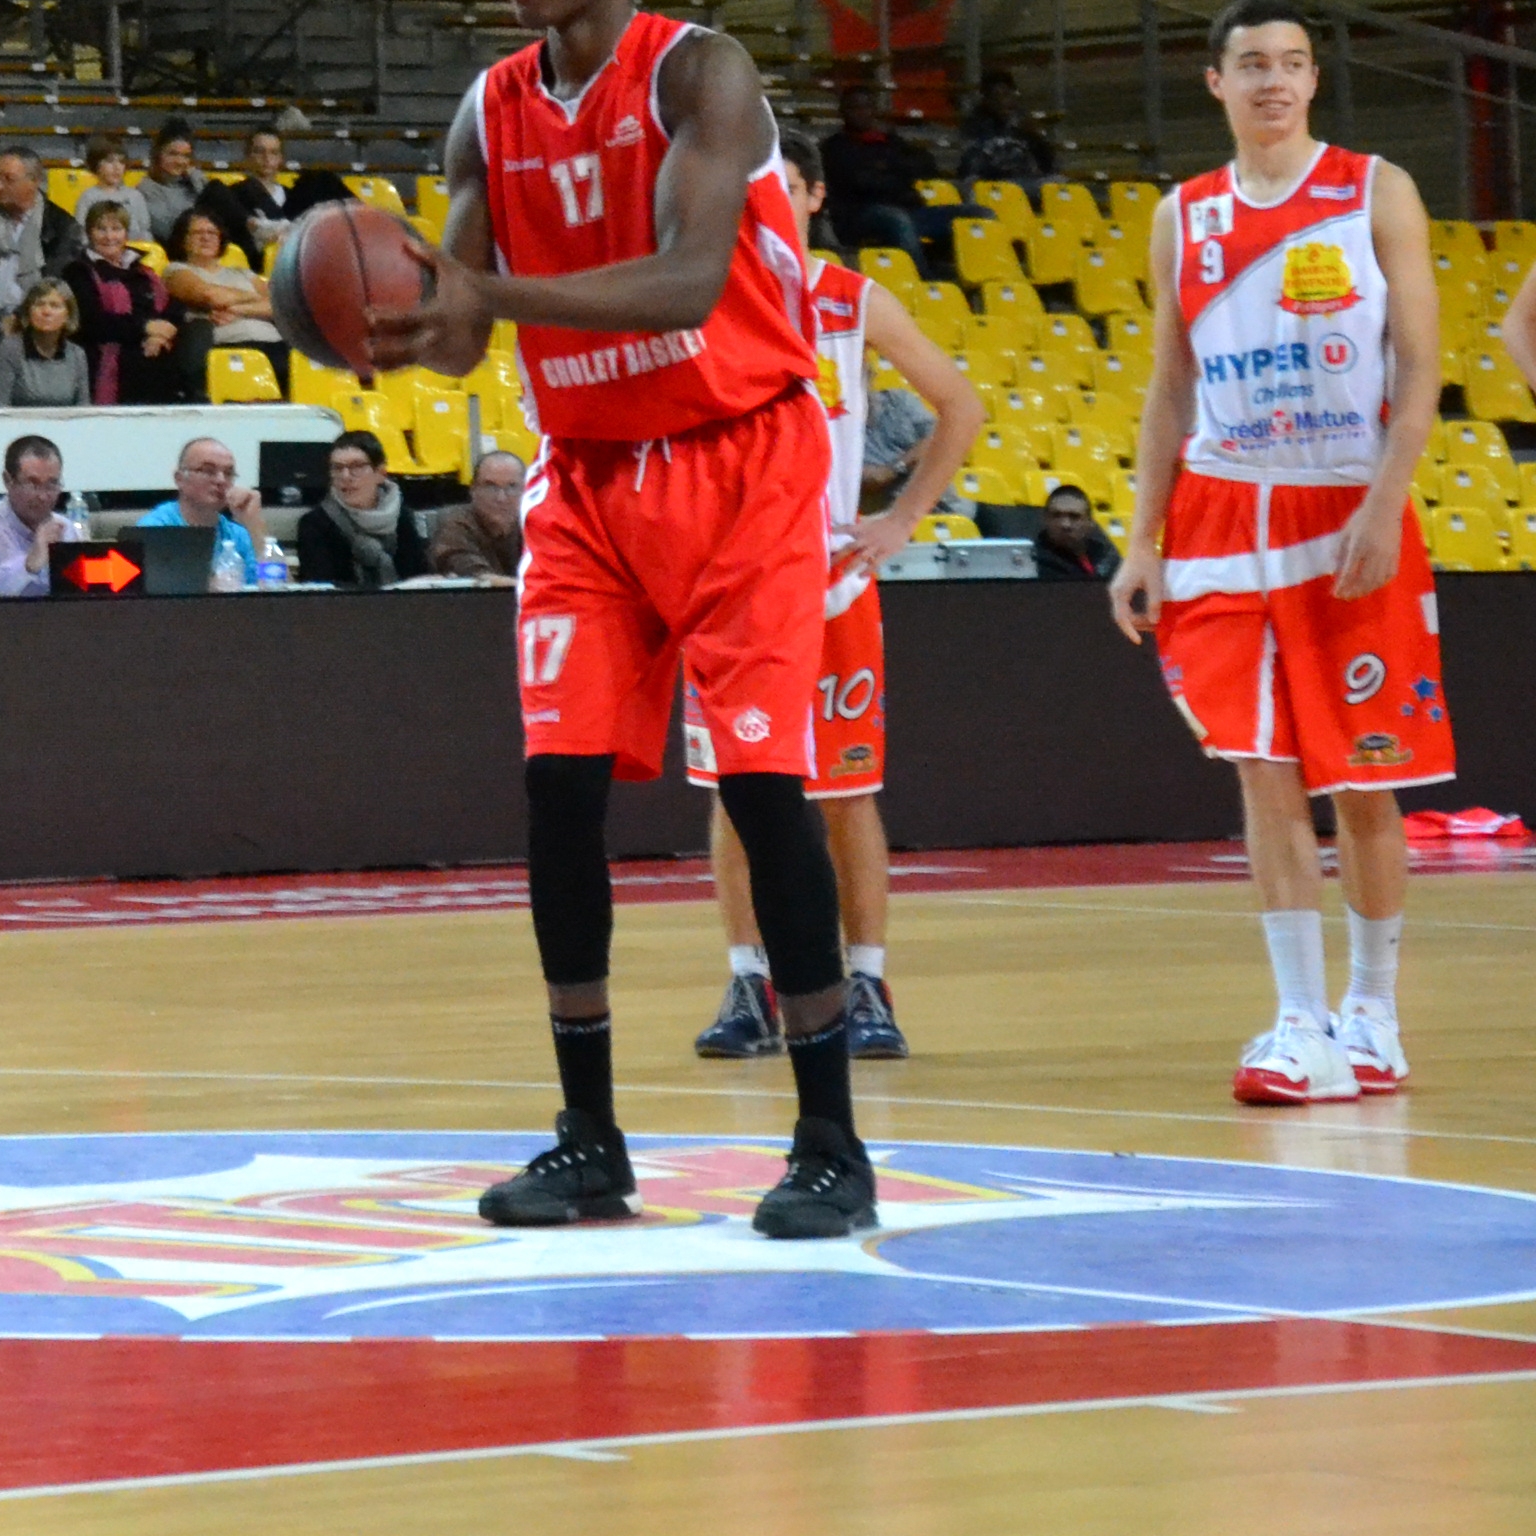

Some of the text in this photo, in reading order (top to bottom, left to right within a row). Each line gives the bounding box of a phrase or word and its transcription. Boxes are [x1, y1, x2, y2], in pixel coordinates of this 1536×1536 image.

[549, 150, 604, 229] 17
[1200, 238, 1225, 285] 9
[1203, 342, 1348, 385] HYPER U
[1253, 383, 1315, 405] Chllans
[519, 614, 577, 687] 17
[817, 667, 876, 722] 10
[1343, 651, 1387, 705] 9
